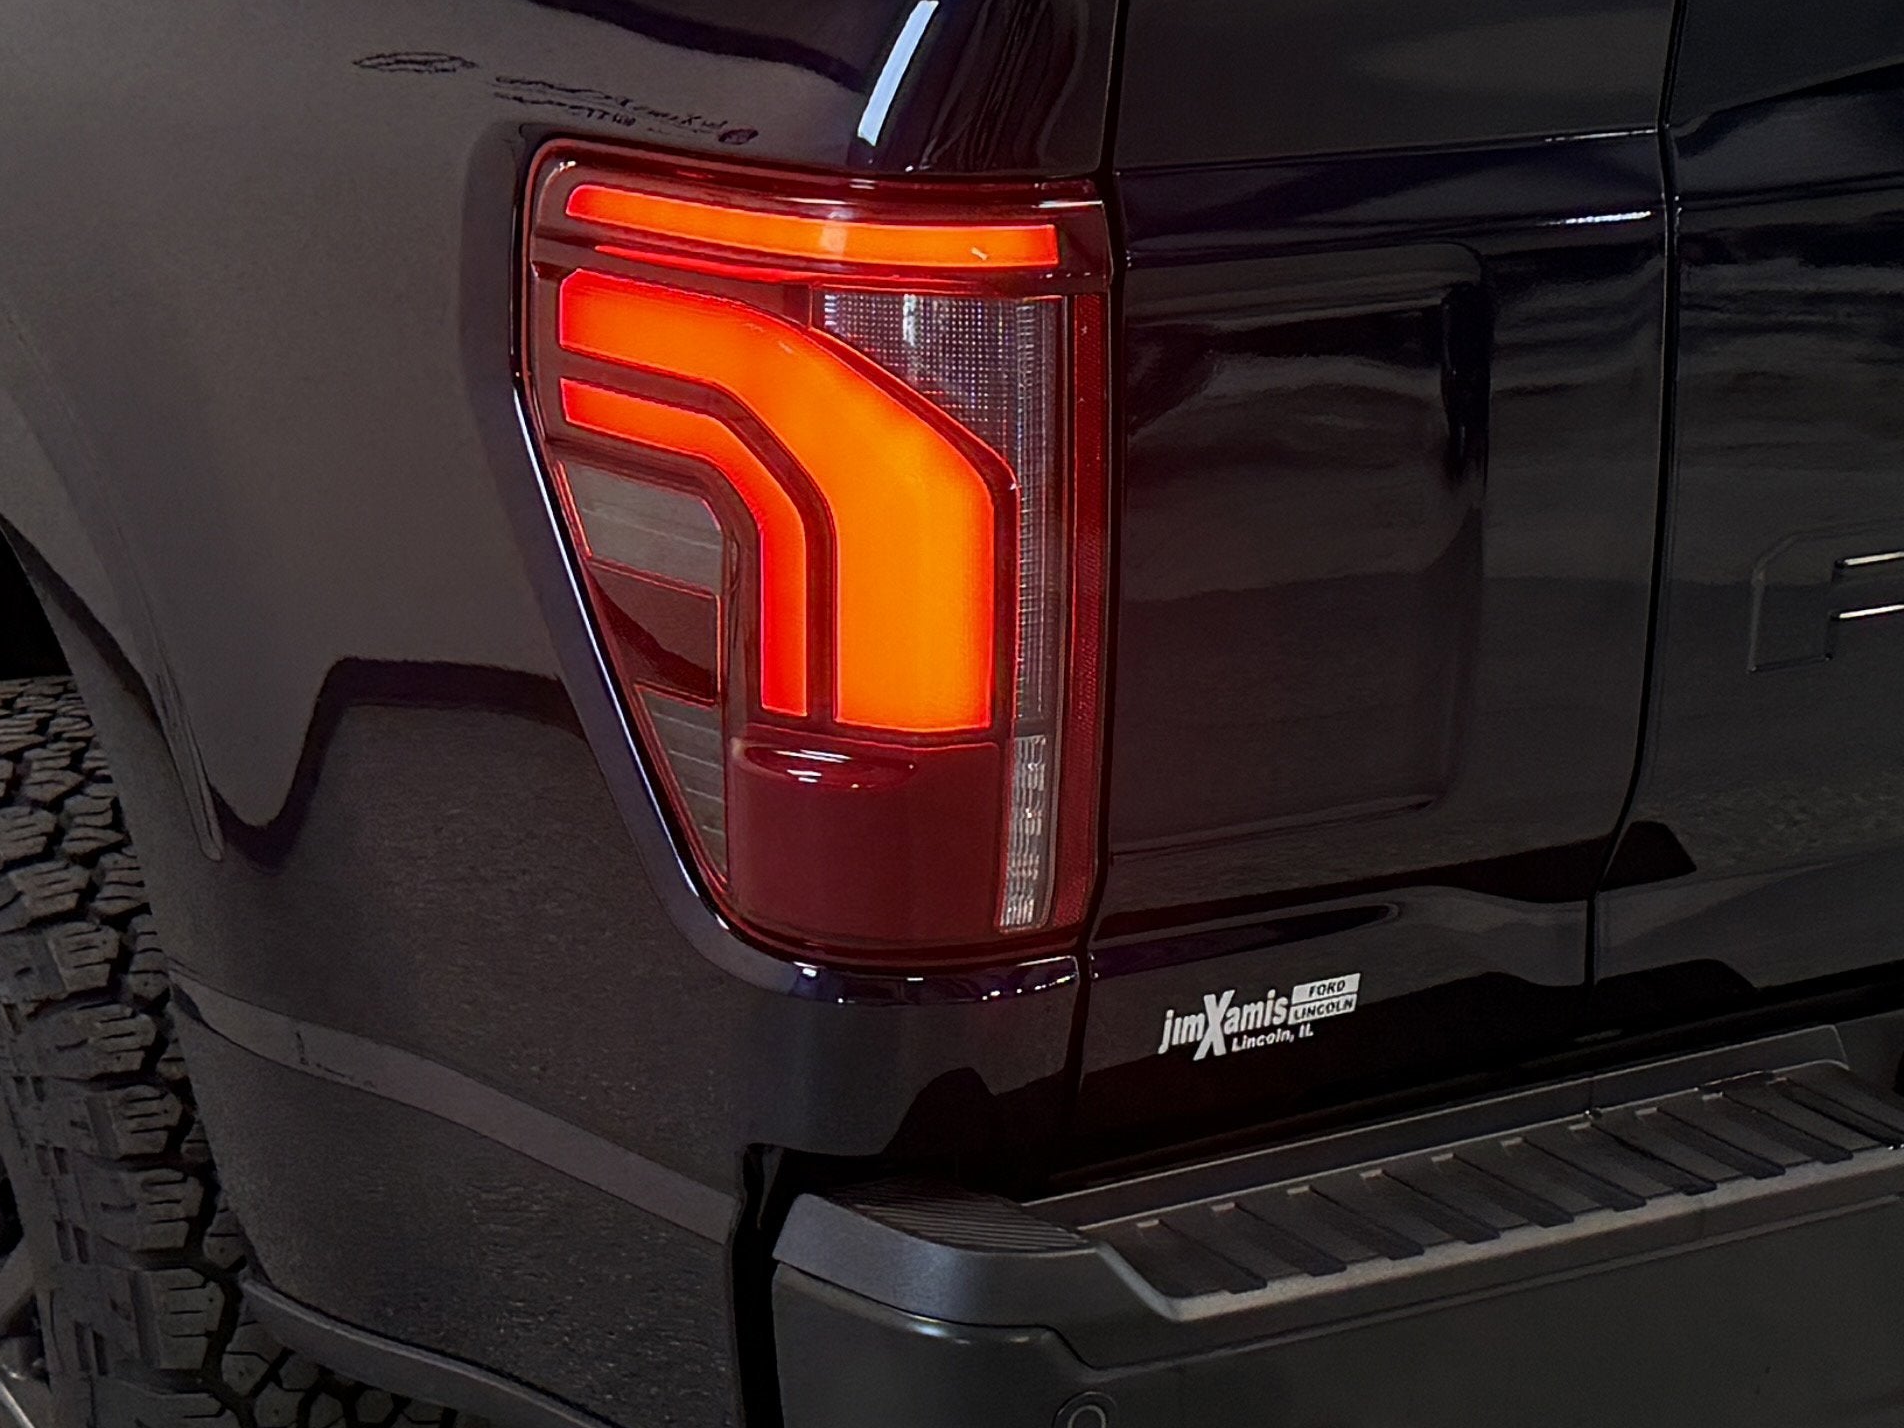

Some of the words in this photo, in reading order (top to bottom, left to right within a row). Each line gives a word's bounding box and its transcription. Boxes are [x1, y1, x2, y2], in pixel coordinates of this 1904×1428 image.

[1307, 978, 1347, 999] FORD
[1294, 997, 1355, 1023] LINCOLN
[1231, 1027, 1296, 1053] Lincoln,
[1298, 1022, 1315, 1039] IL
